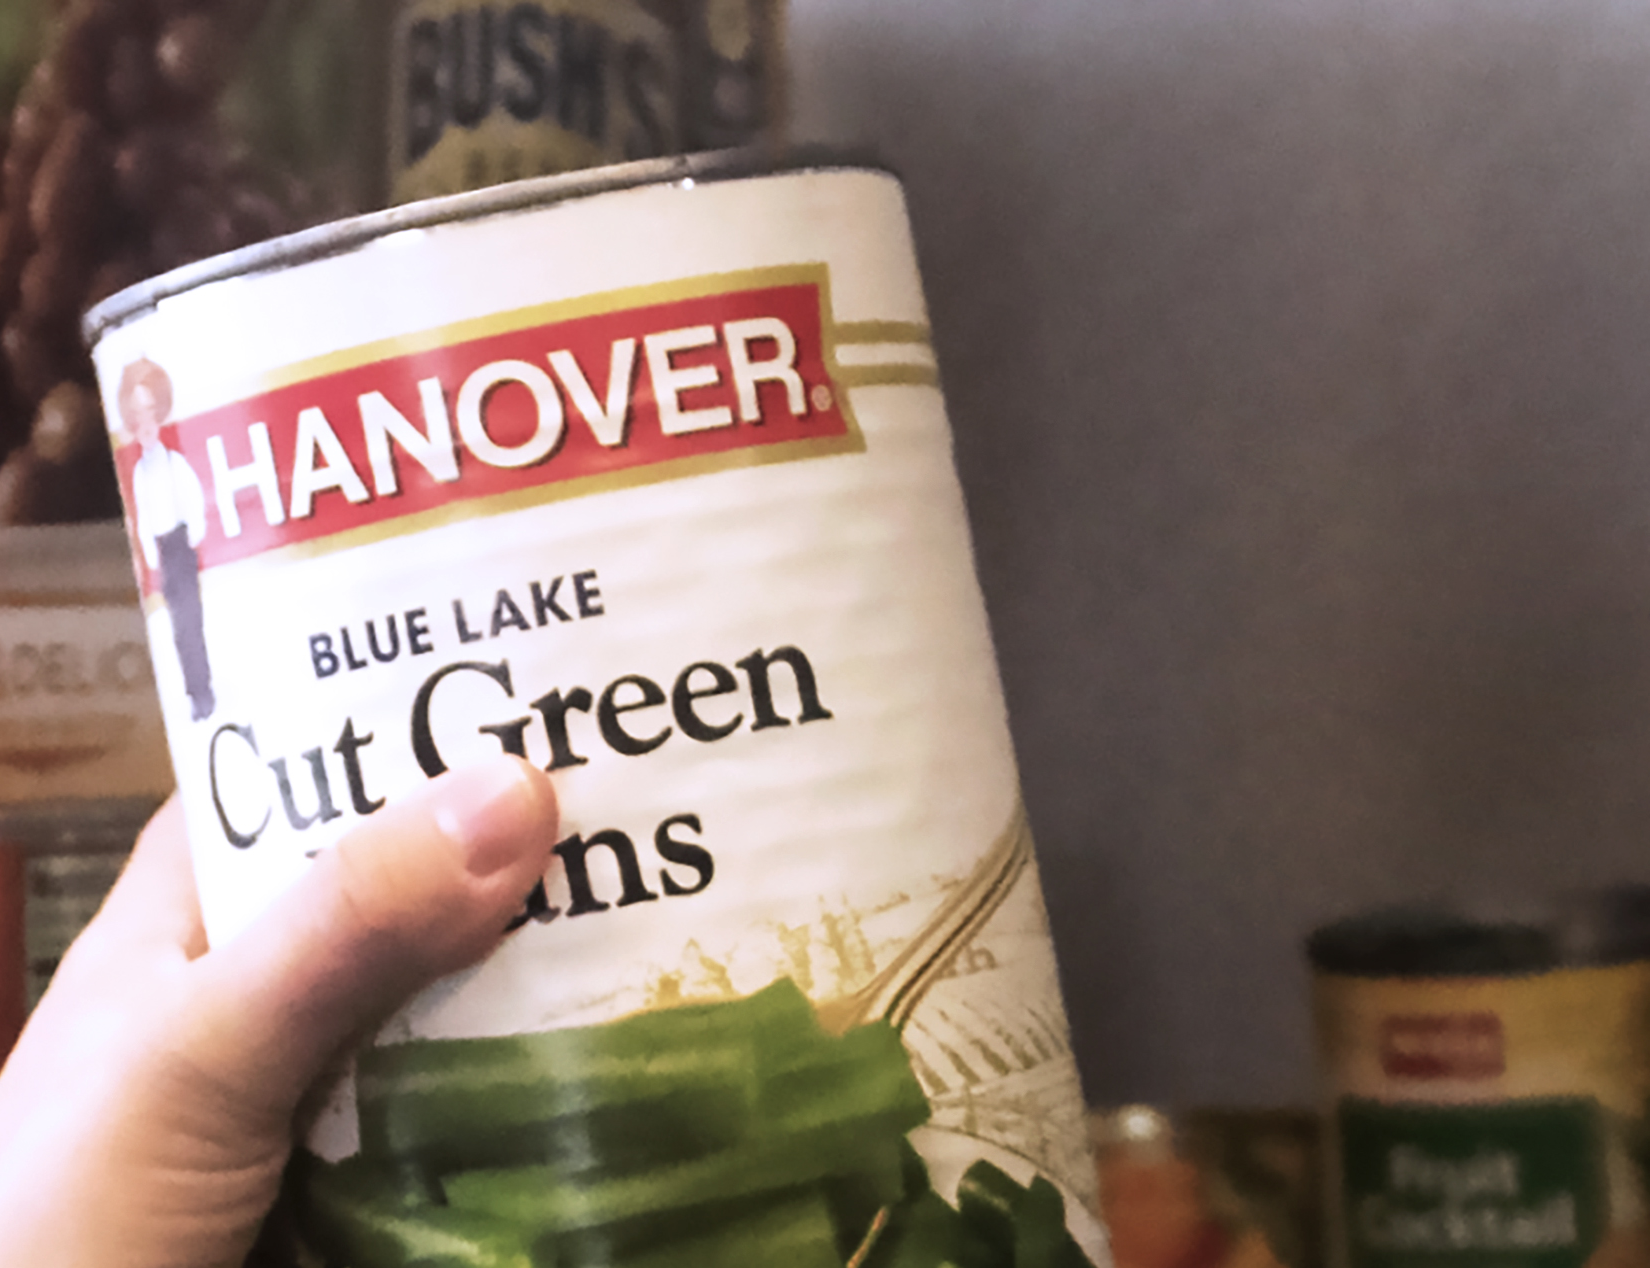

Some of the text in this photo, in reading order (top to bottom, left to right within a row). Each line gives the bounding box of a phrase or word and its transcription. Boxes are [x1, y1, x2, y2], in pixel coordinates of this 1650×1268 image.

[205, 316, 810, 539] HANOVER
[309, 569, 606, 679] BLUE LAKE
[208, 641, 833, 850] Cut Green
